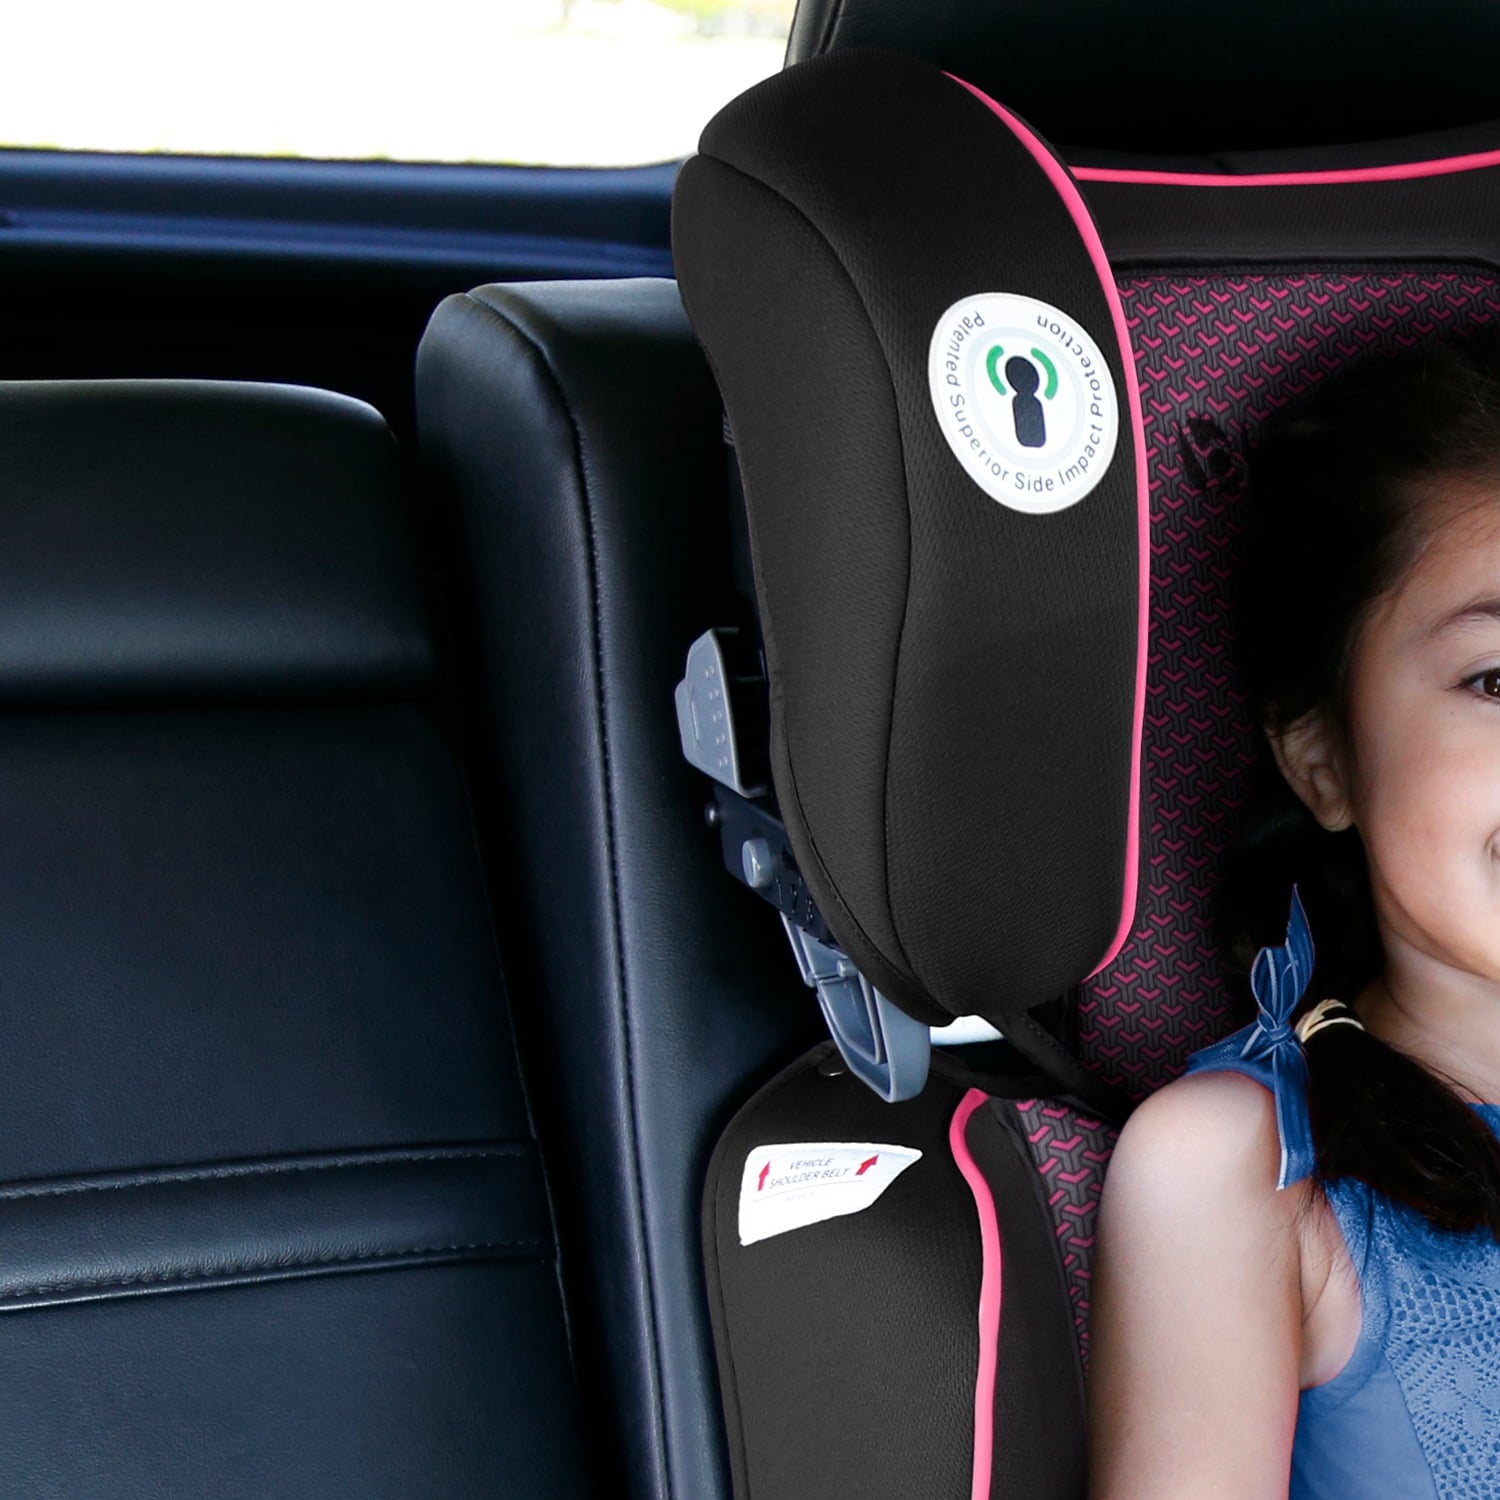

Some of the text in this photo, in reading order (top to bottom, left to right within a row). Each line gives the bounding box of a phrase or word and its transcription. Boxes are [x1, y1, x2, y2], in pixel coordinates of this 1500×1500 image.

[945, 310, 1104, 493] Patented Superior Side Impact Protection
[789, 1157, 835, 1170] VEHICLE
[769, 1167, 850, 1189] SHOULDER BELT
